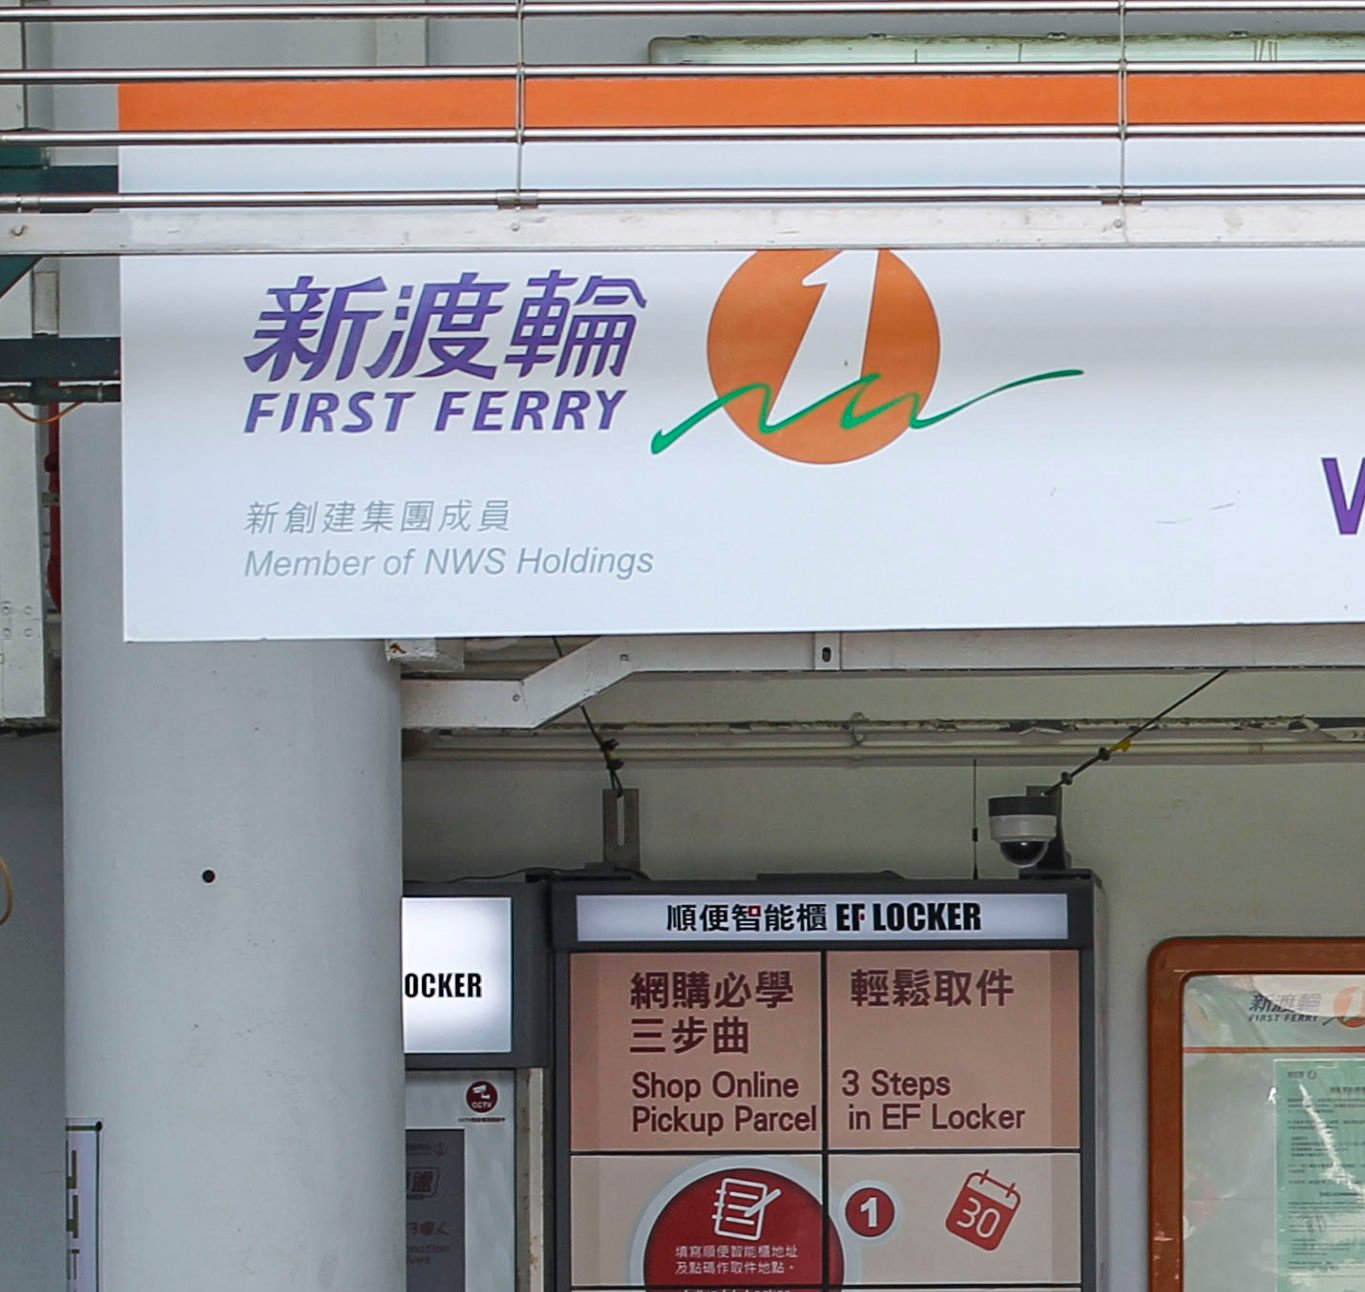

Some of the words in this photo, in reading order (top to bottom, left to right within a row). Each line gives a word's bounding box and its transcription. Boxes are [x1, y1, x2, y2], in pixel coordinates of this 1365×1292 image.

[243, 270, 648, 382] 新渡輪
[244, 391, 416, 433] FIRST
[435, 388, 628, 432] FERRY
[244, 499, 512, 537] 新創建集團成員
[243, 548, 375, 580] Member
[382, 547, 414, 577] of
[425, 547, 507, 577] NWS
[516, 545, 654, 582] Holdings
[667, 904, 827, 932] 順便智能櫃
[836, 904, 865, 931] EF
[872, 902, 983, 931] LOCKER
[630, 971, 794, 1009] 網購必學
[851, 968, 1014, 1007] 輕鬆取件
[630, 1016, 749, 1054] 三步曲
[632, 1071, 701, 1102] Shop
[712, 1071, 799, 1098] Online
[842, 1069, 860, 1096] 3
[871, 1069, 951, 1100] Steps
[632, 1105, 724, 1136] Pickup
[735, 1105, 817, 1131] Parcel
[849, 1103, 871, 1130] in
[882, 1103, 921, 1130] EF
[932, 1103, 1026, 1129] Locker
[859, 1197, 879, 1227] 1
[956, 1199, 1000, 1239] 30
